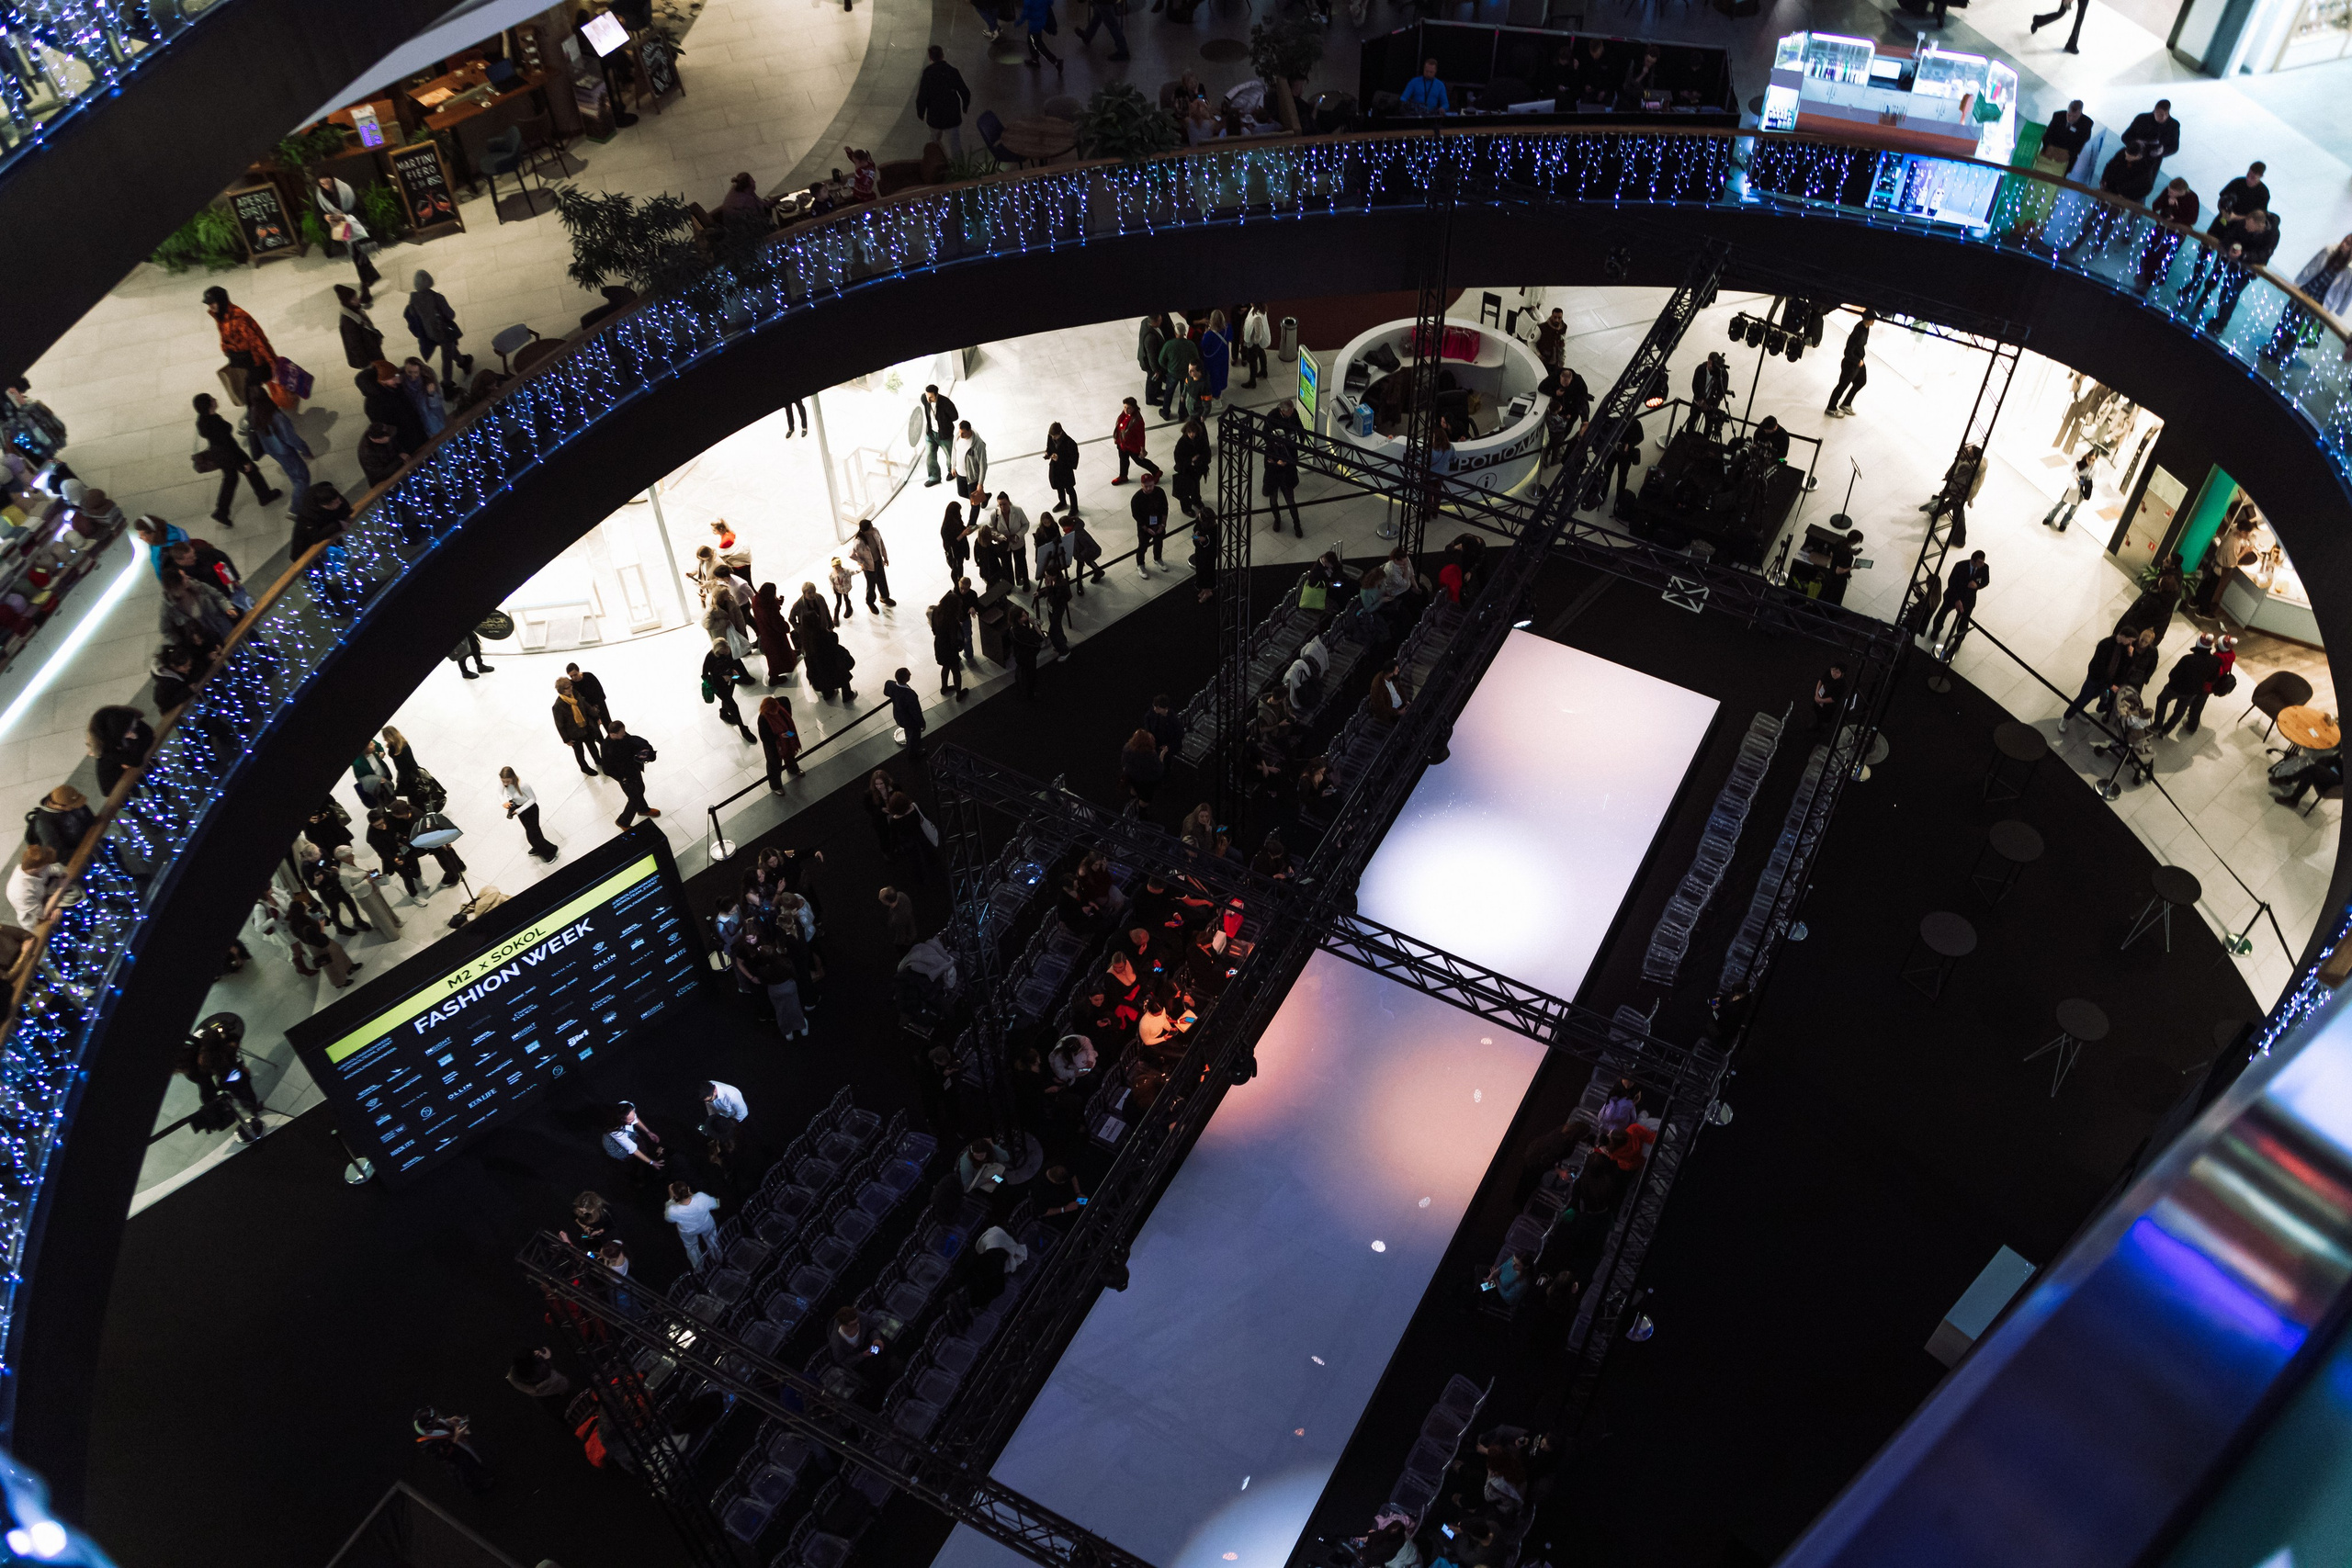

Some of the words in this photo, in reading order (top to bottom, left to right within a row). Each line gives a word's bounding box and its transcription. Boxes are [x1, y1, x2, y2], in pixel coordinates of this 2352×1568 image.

[396, 152, 436, 172] MARTINI
[405, 164, 436, 180] FIERO
[1450, 423, 1544, 472] РОПОЛИ
[621, 921, 639, 934] SOKOL
[659, 917, 676, 929] SOKOL
[447, 969, 472, 988] M2
[490, 925, 546, 963] SOKOL
[592, 953, 616, 970] OLLIN
[664, 953, 678, 964] ROCK
[413, 962, 522, 1035] FASHION
[521, 918, 595, 969] WEEK
[640, 1001, 664, 1019] INSIGHT
[512, 1022, 537, 1040] INSIGHT
[557, 1018, 574, 1031] SOKOL
[473, 1030, 492, 1043] SOKOL
[567, 1029, 590, 1047] girl
[424, 1036, 452, 1055] INSIGHT
[447, 1082, 472, 1100] OLLIN
[481, 1088, 498, 1100] LIFE
[390, 1145, 405, 1157] ROCK
